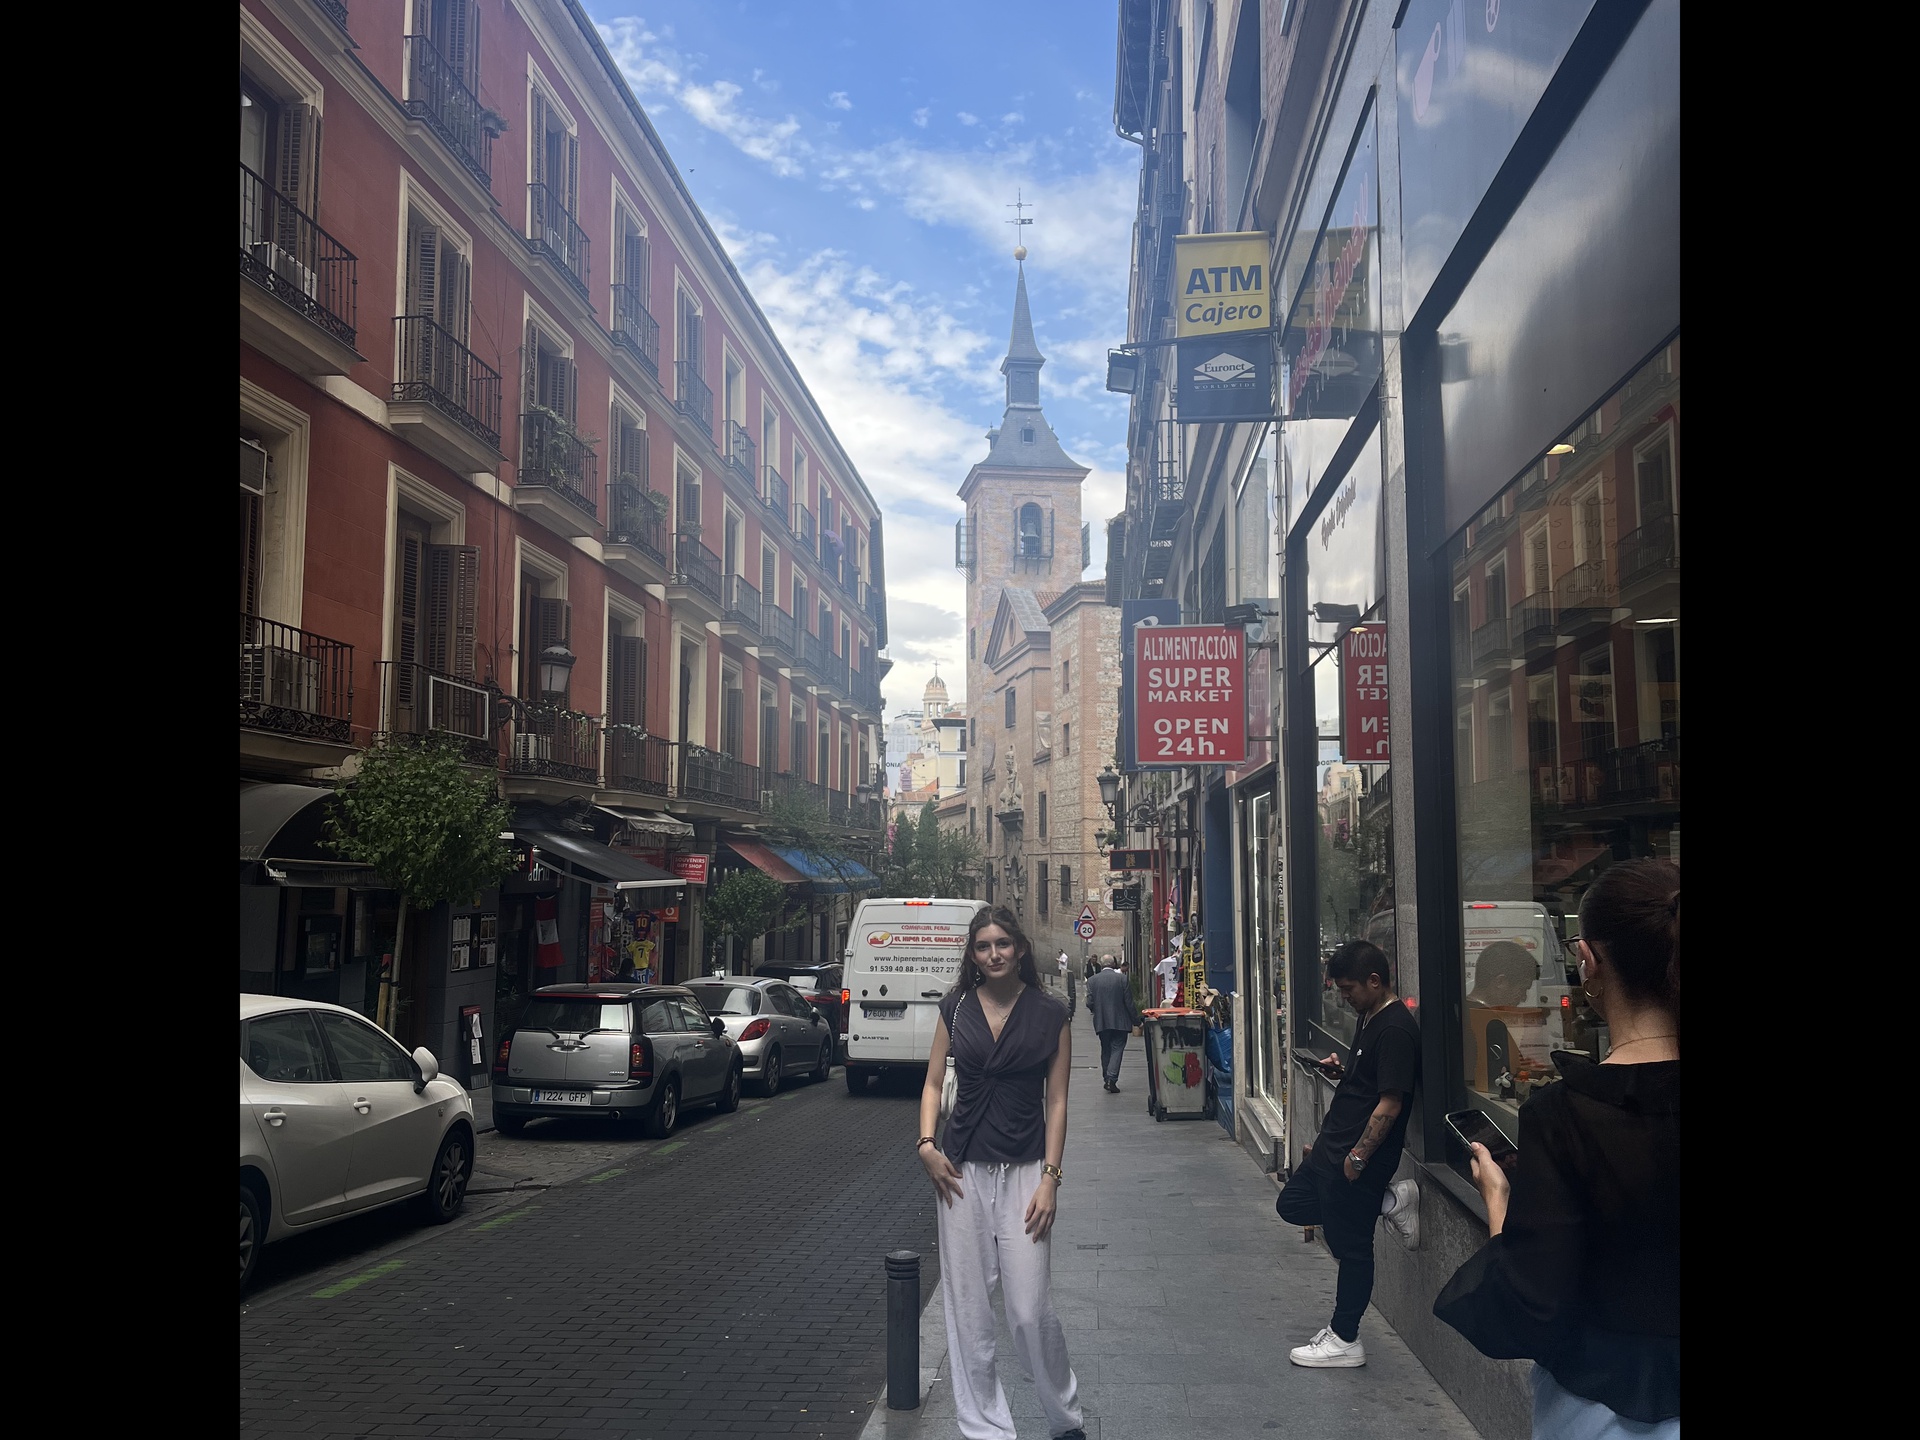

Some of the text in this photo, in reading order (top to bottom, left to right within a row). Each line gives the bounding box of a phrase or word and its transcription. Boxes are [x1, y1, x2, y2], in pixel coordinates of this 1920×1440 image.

[1185, 264, 1262, 295] ATM
[1185, 301, 1263, 326] Cajero
[1204, 363, 1245, 373] Euronet
[1193, 382, 1256, 390] WORLDWIDE
[1143, 629, 1237, 661] ALIMENTACIÓN
[1148, 666, 1232, 688] SUPER
[1148, 689, 1233, 703] MARKET
[1153, 718, 1229, 735] OPEN
[1157, 736, 1226, 756] 24h.
[636, 917, 648, 928] 10
[638, 947, 645, 958] 7
[874, 955, 961, 964] www.hiperembalaje.com
[542, 1091, 587, 1102] 1224 GFP
